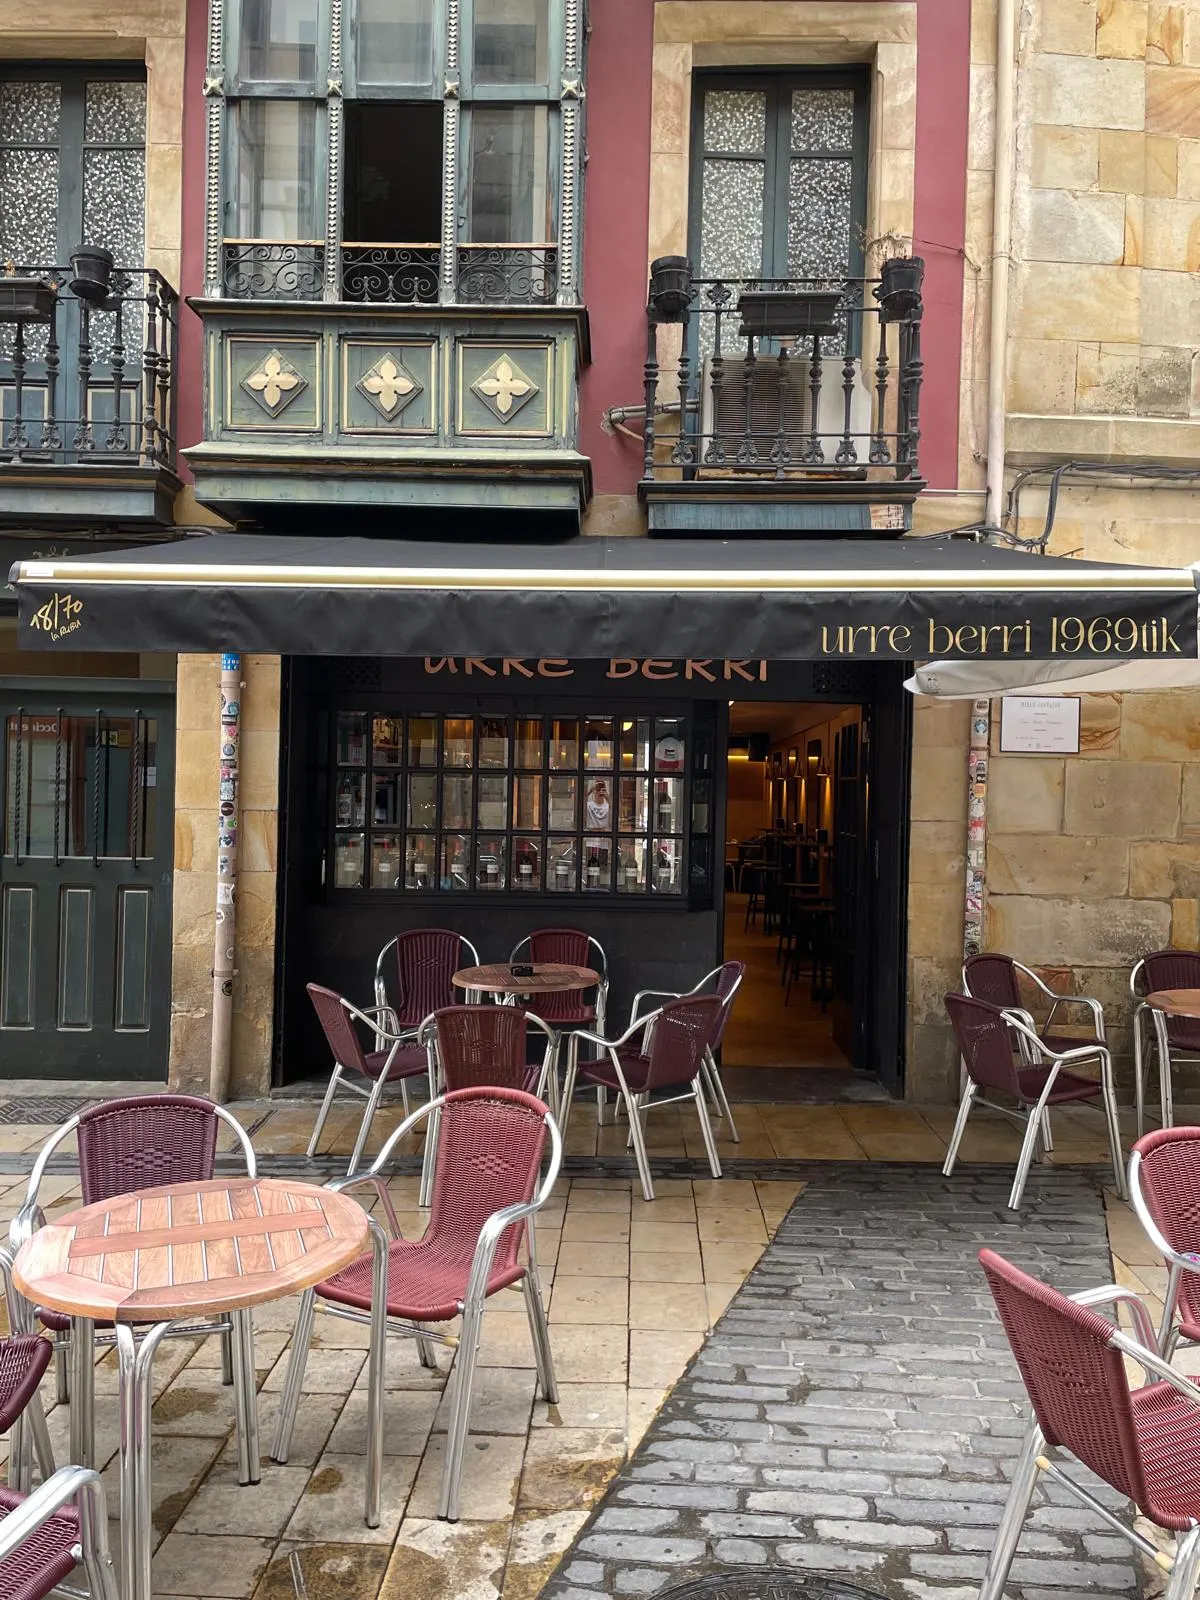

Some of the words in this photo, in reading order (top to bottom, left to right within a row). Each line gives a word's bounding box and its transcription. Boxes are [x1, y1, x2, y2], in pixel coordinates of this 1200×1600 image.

[820, 624, 912, 654] urre
[928, 618, 1032, 654] berri
[1051, 616, 1182, 654] 1969tik
